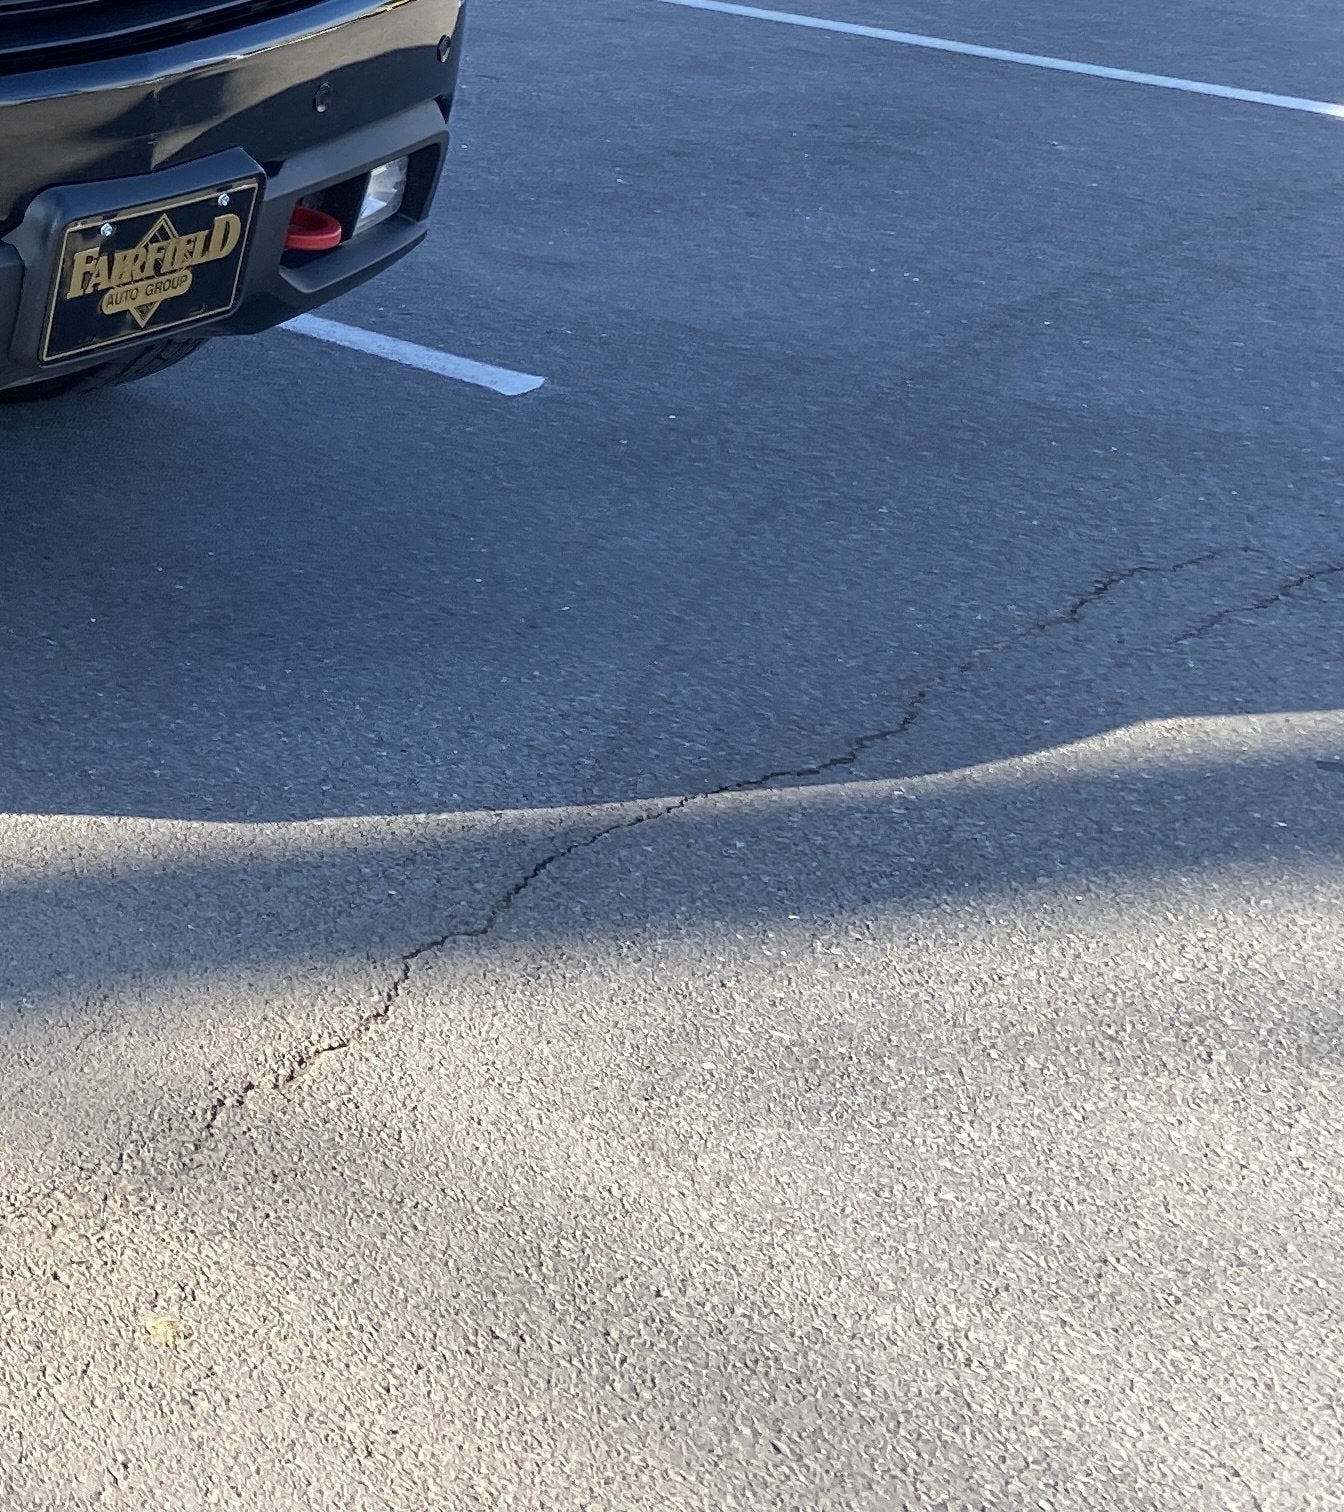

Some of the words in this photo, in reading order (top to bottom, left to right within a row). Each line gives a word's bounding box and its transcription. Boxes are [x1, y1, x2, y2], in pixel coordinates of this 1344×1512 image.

[66, 213, 243, 299] FAIRFIELD
[105, 287, 140, 309] AUTO
[144, 274, 190, 299] GROUP
